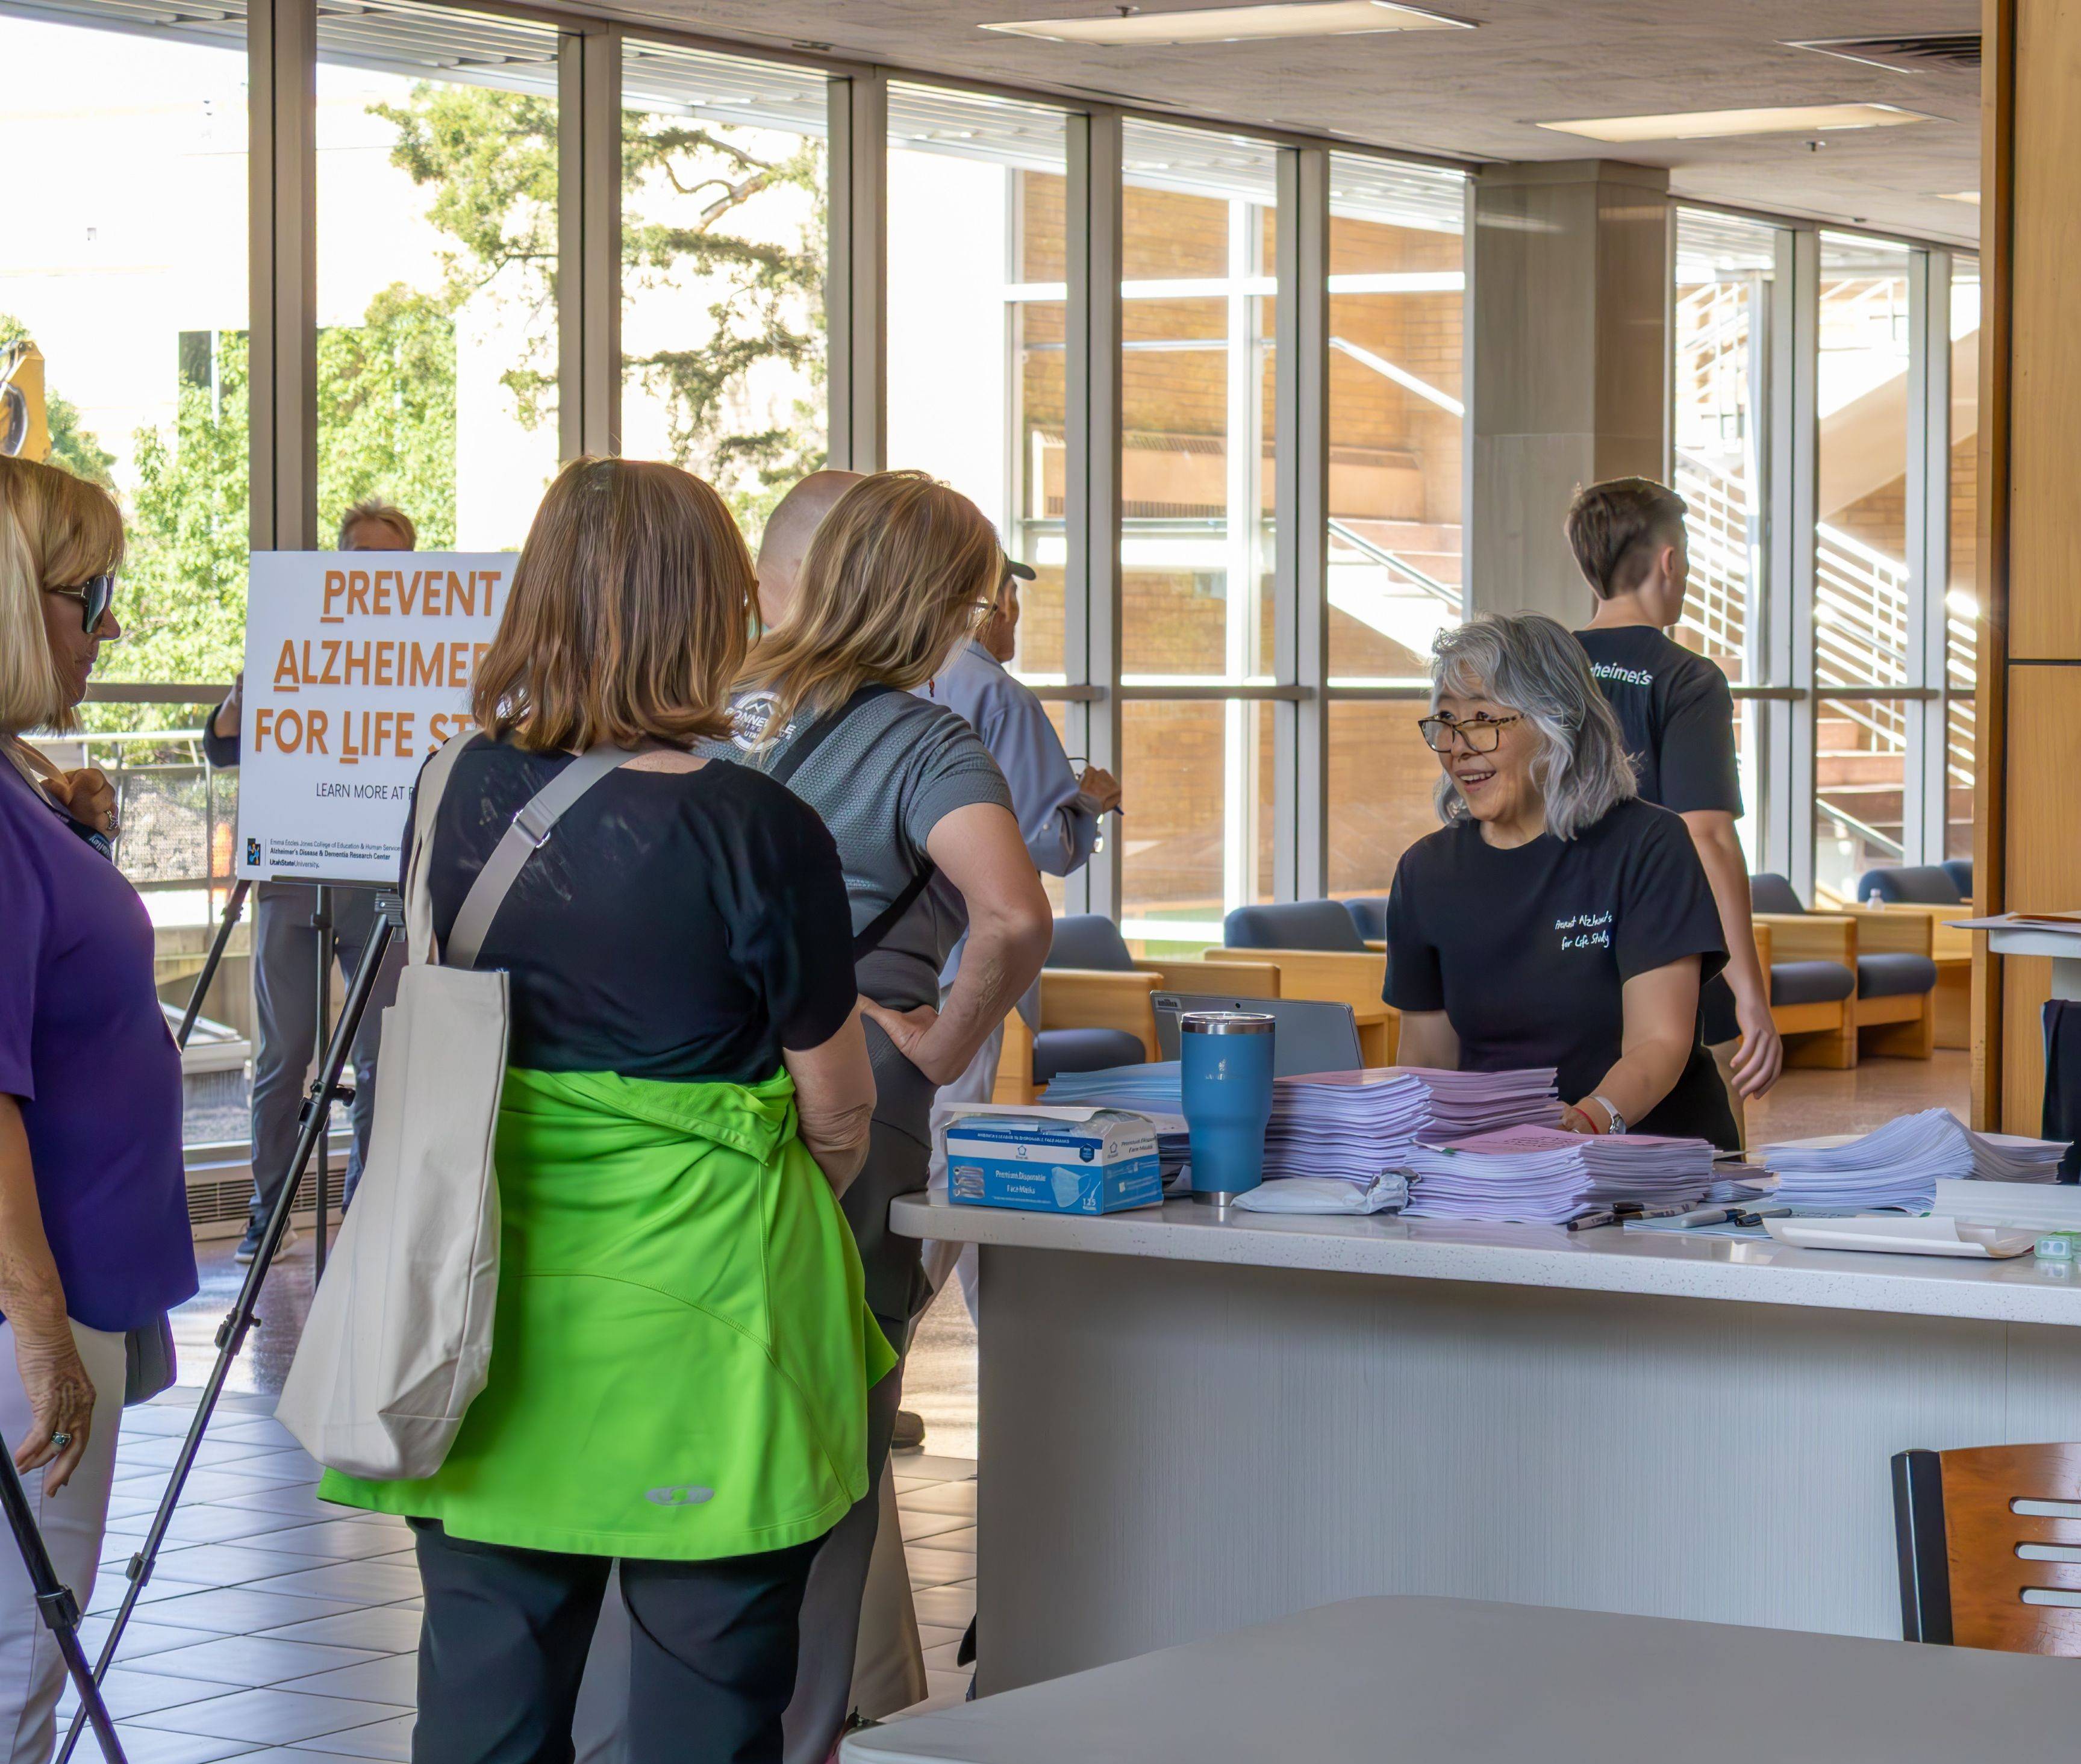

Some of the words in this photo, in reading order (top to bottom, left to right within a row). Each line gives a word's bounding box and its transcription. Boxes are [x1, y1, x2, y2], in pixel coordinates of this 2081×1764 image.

[321, 570, 502, 617] PREVENT
[1590, 662, 1653, 685] heimer's
[255, 708, 328, 755] FOR
[342, 711, 415, 758] LIFE
[316, 782, 351, 798] LEARN
[354, 784, 388, 800] MORE
[391, 786, 405, 800] AT
[270, 847, 298, 856] Alzheimer's
[324, 850, 348, 858] Dementia
[314, 841, 331, 849] College
[1561, 936, 1573, 951] for
[1574, 934, 1590, 949] Life
[1590, 929, 1611, 949] Study
